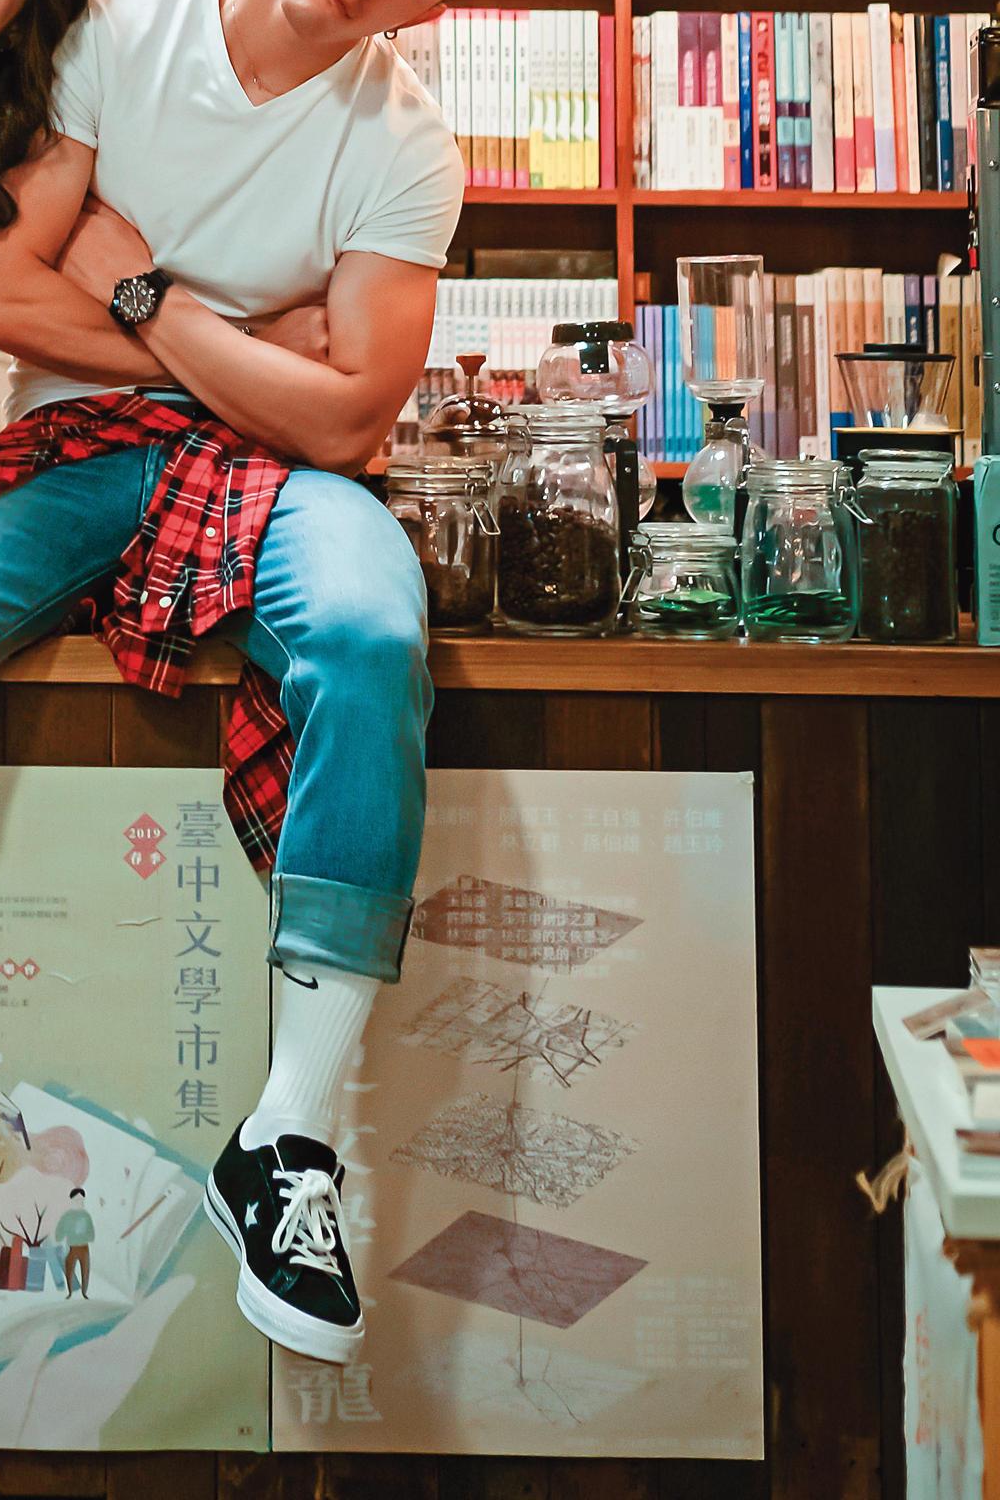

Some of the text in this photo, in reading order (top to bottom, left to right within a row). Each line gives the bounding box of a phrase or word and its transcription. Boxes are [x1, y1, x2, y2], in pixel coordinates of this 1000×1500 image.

[128, 827, 161, 840] 2019
[173, 801, 223, 1129] 臺中文學市集
